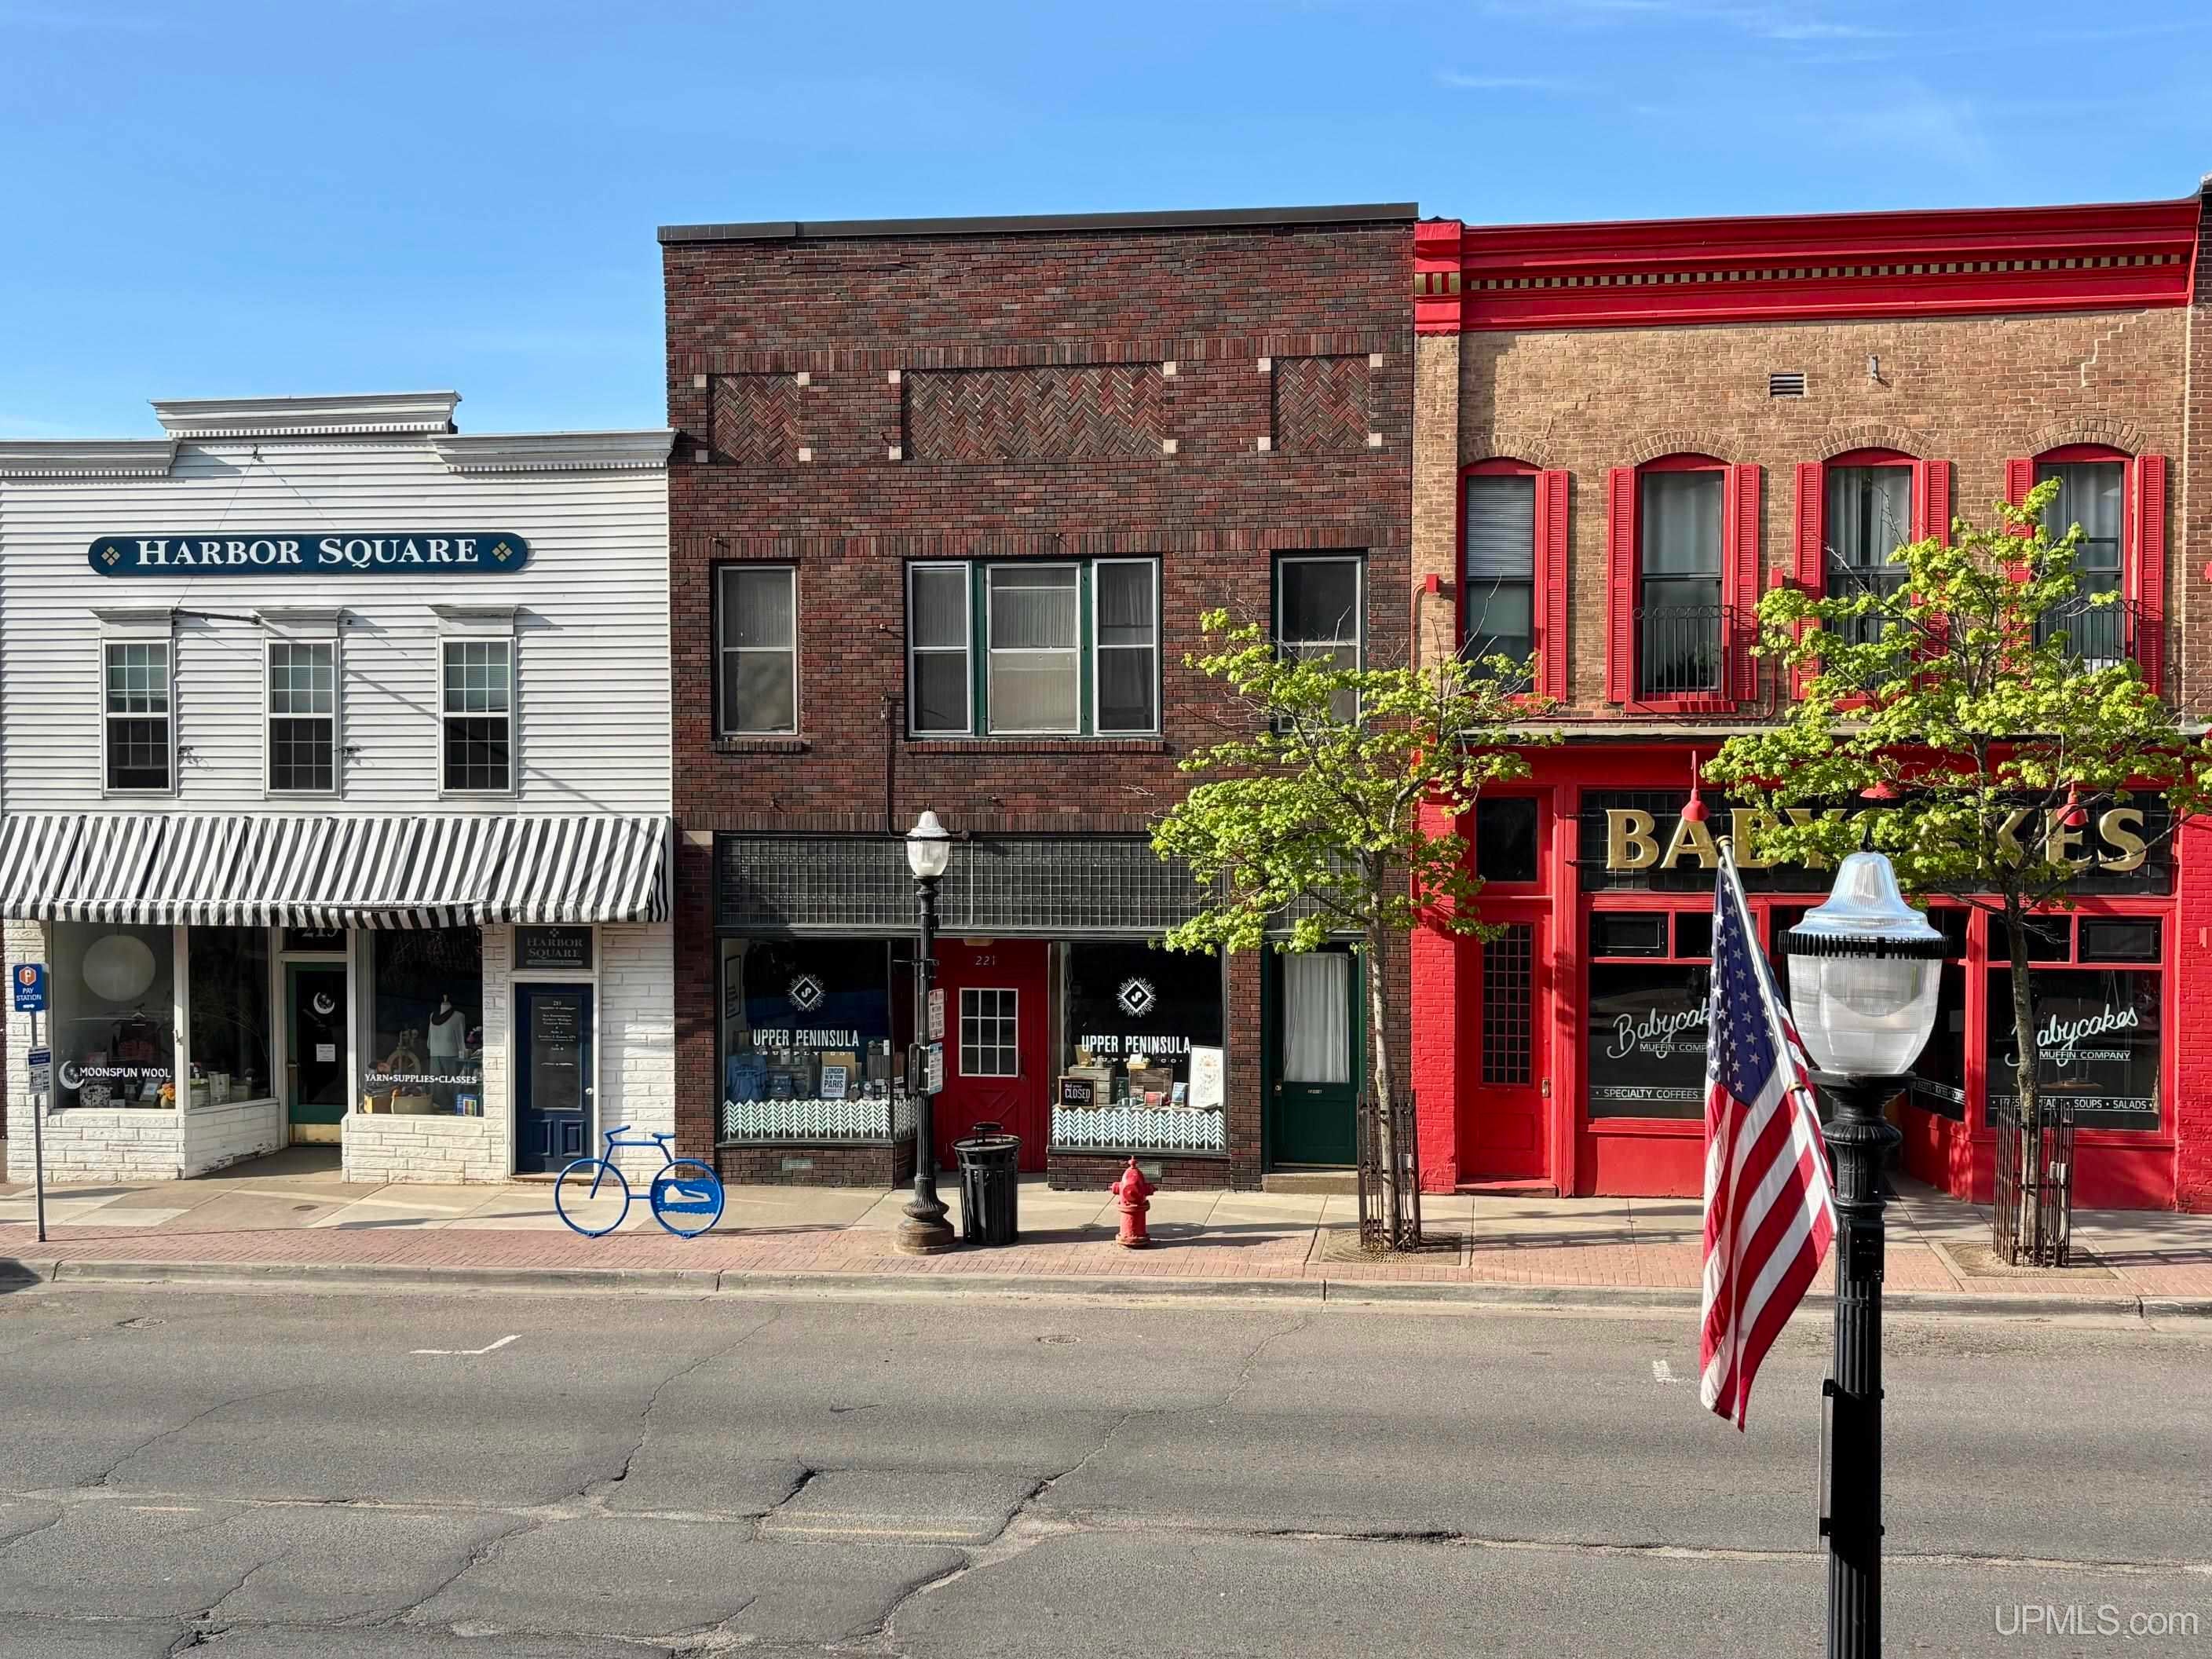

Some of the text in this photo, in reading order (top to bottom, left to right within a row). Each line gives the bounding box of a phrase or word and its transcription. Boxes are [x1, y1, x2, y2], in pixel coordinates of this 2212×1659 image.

[136, 538, 478, 568] HARBOR SQUARE
[1605, 807, 2148, 872] BABKES
[527, 937, 583, 948] HARBOR
[528, 948, 582, 959] SQUARE
[974, 955, 996, 967] 221
[1607, 997, 1710, 1058] Babycak
[754, 1029, 860, 1047] UPPER PENINSULA
[2005, 1003, 2139, 1067] abycakes
[1081, 1035, 1191, 1054] UPPER PENINSULA
[1640, 1043, 1708, 1052] MUFFIN COMP
[2040, 1051, 2131, 1060] MUFFIN COMPANY
[79, 1067, 172, 1079] MOONSPUN WOOL
[824, 1080, 843, 1088] PARIS
[1065, 1087, 1091, 1099] CLOSED
[1603, 1088, 1698, 1099] SPECIALTY COFFEES
[2074, 1099, 2103, 1109] SOUPS
[2113, 1099, 2148, 1109] SALADS
